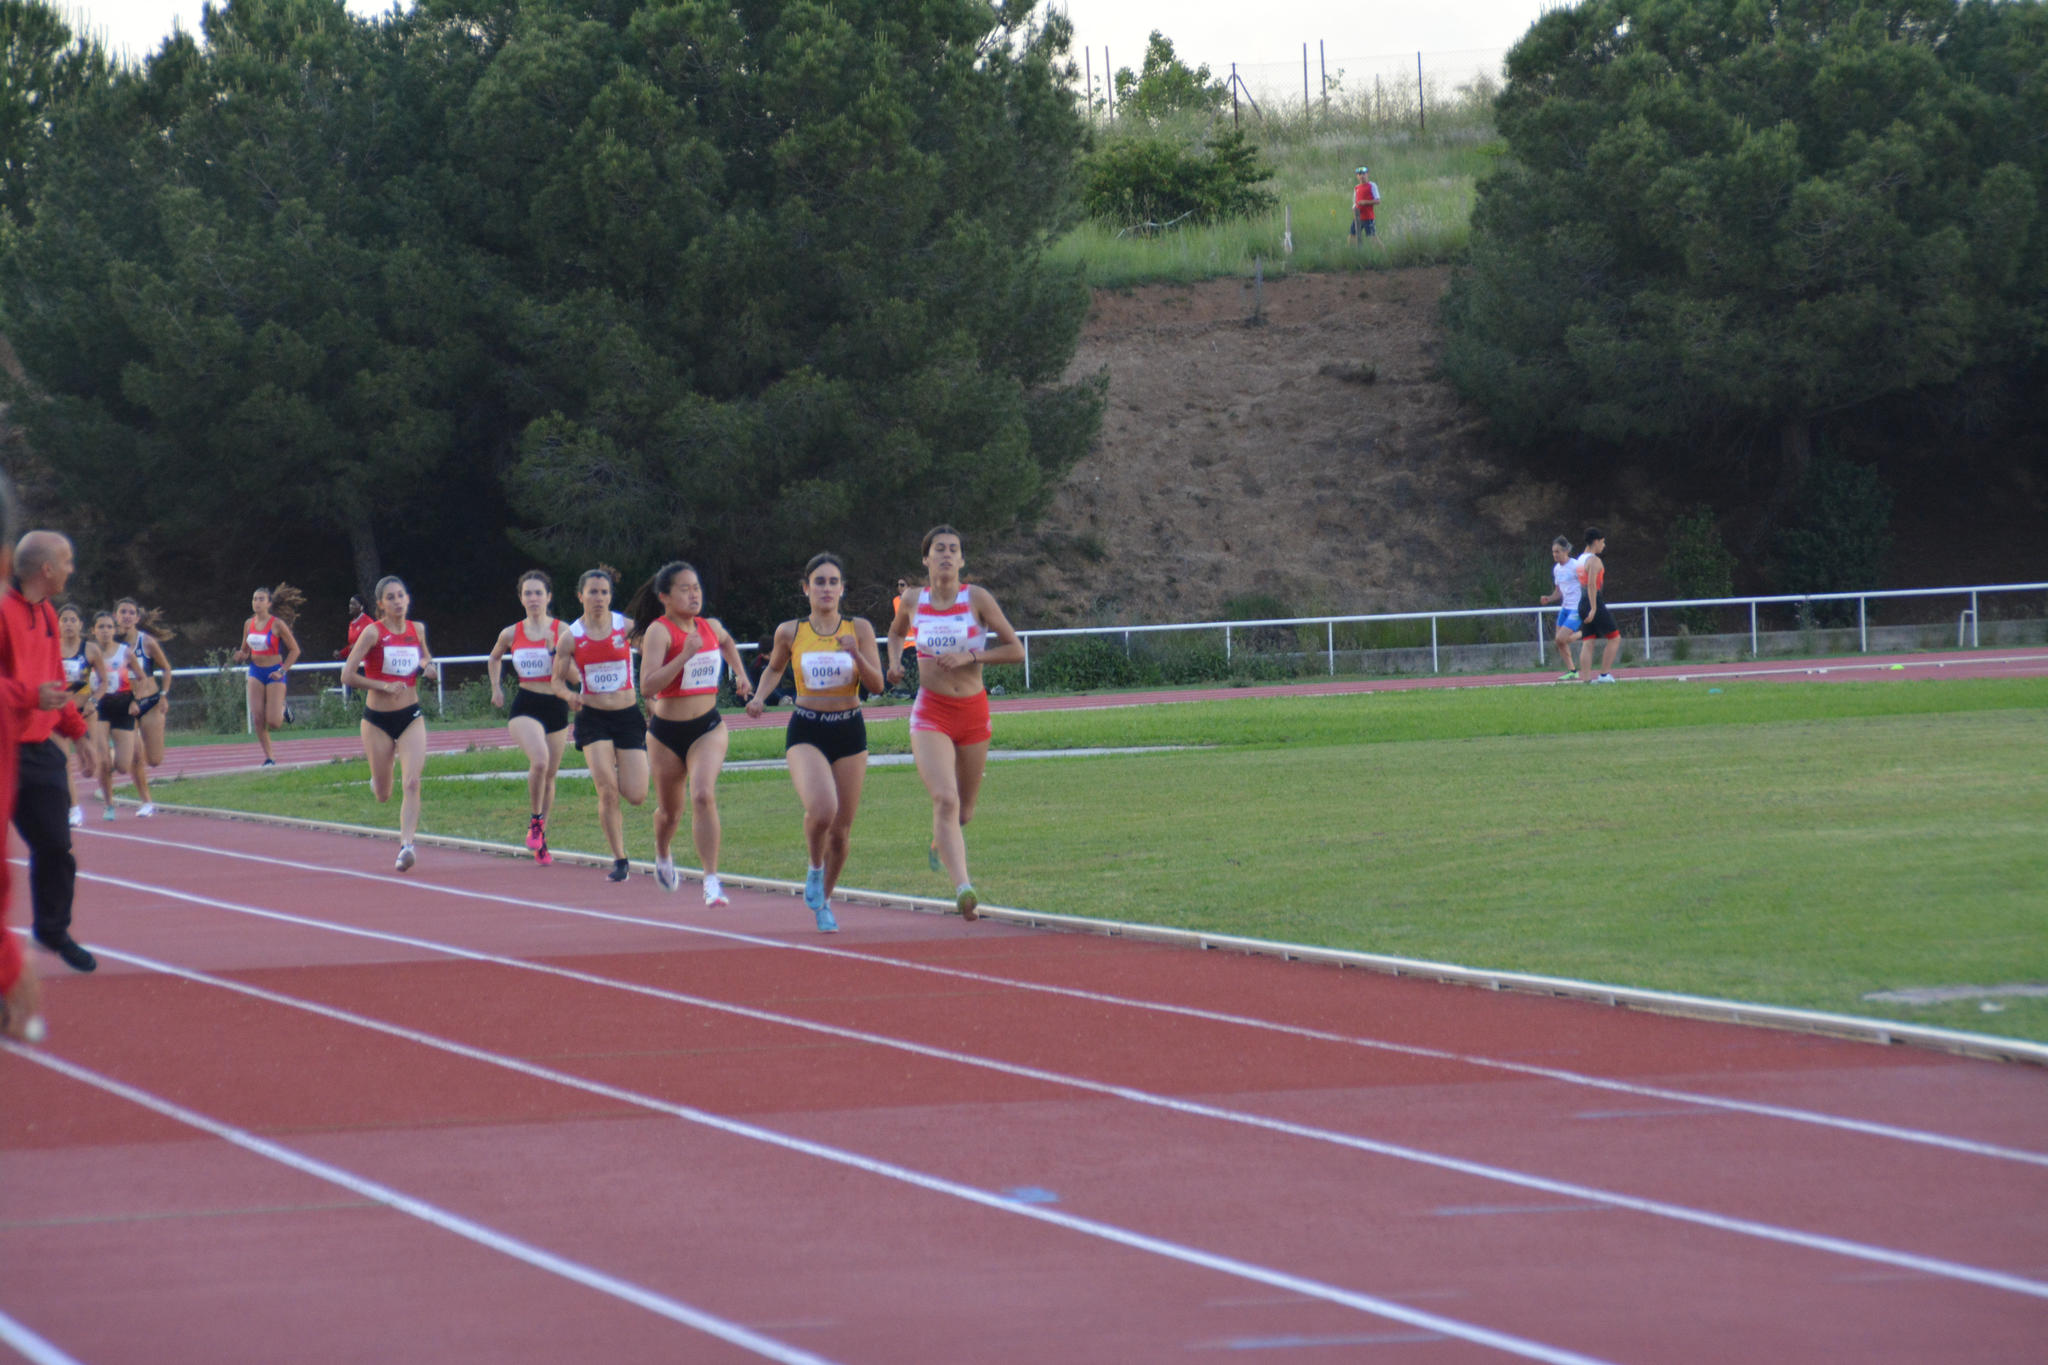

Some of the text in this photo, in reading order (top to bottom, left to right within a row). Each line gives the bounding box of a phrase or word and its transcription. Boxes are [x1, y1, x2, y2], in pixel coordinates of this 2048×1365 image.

[927, 636, 956, 648] 0029
[391, 658, 412, 667] 0101
[520, 659, 543, 669] 0060
[812, 666, 841, 678] 0084
[594, 673, 618, 684] 0003
[820, 710, 851, 722] NIKE
